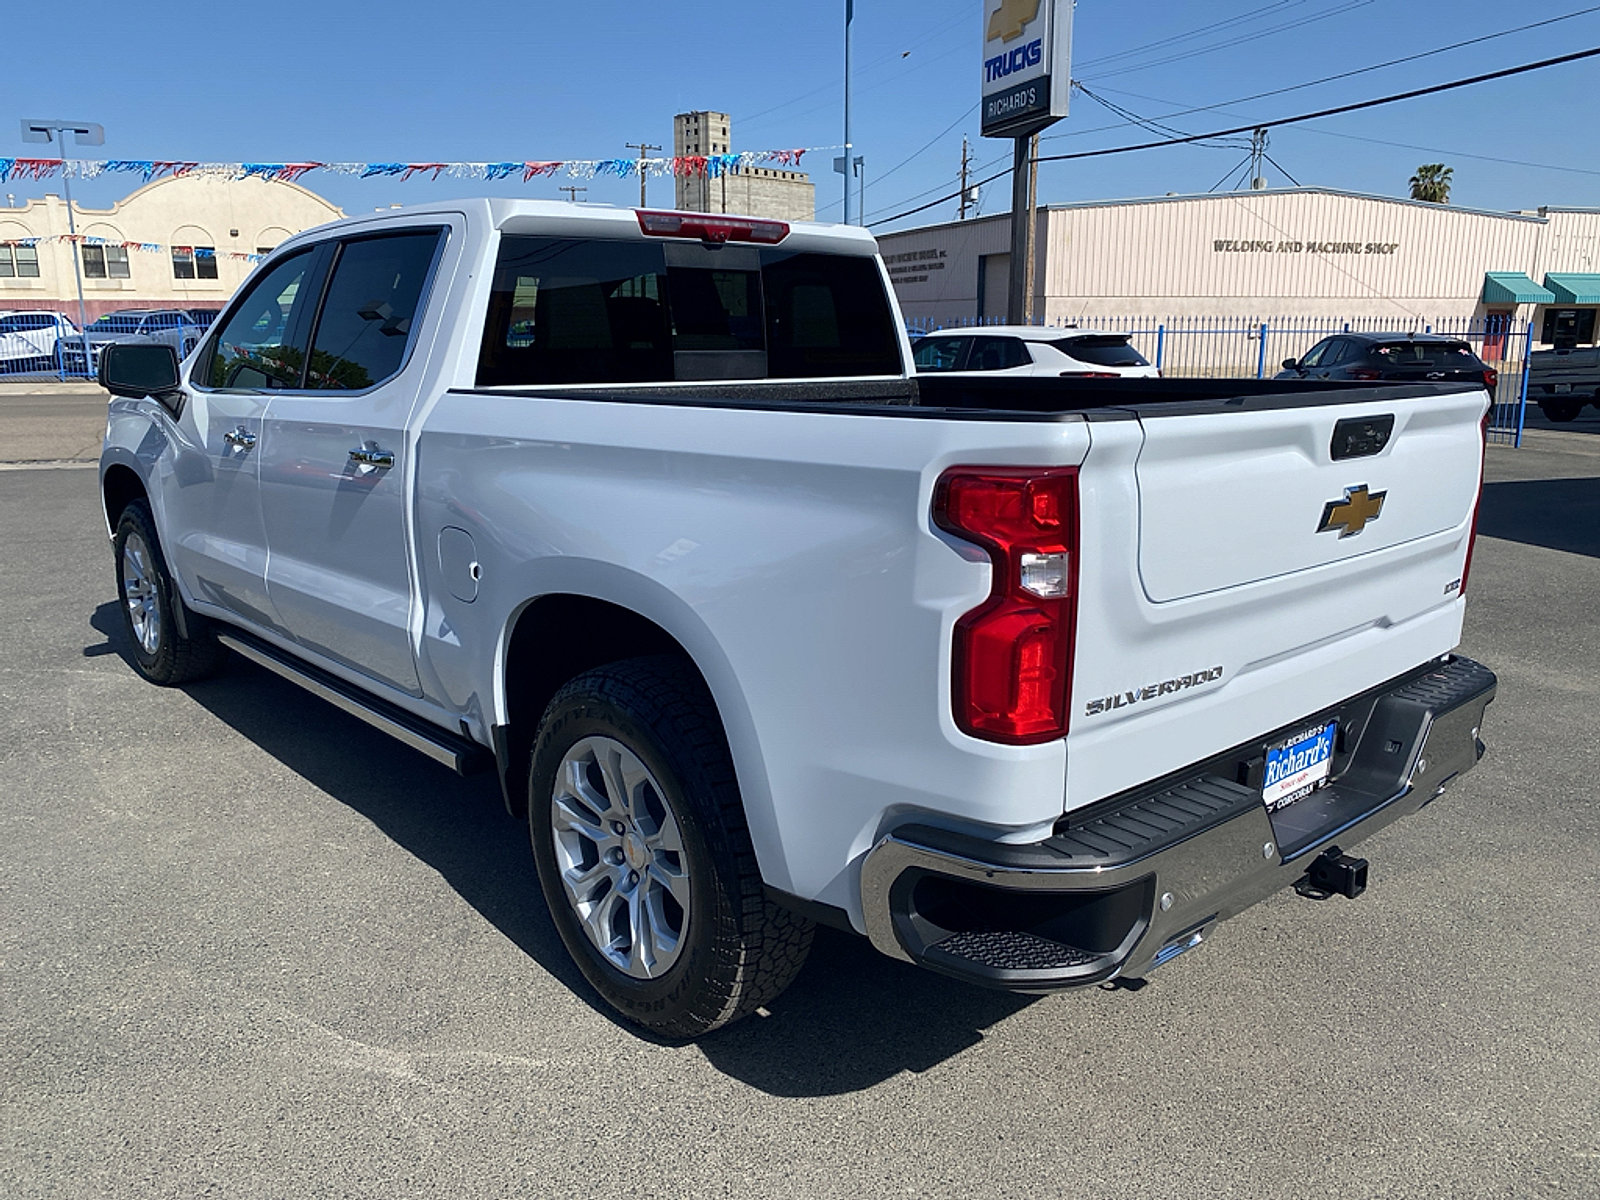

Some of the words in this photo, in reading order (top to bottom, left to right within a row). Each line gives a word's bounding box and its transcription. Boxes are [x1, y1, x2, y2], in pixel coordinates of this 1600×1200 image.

[984, 38, 1042, 82] TRUCKS
[988, 87, 1036, 118] RICHARD'S
[1213, 239, 1273, 253] WELDING
[1276, 240, 1304, 253] AND
[1306, 241, 1362, 255] MACHINE
[1364, 242, 1400, 255] SHOP
[1084, 665, 1223, 716] SILVERADO
[1264, 736, 1330, 787] Richard's
[1277, 784, 1314, 809] CORCORAN
